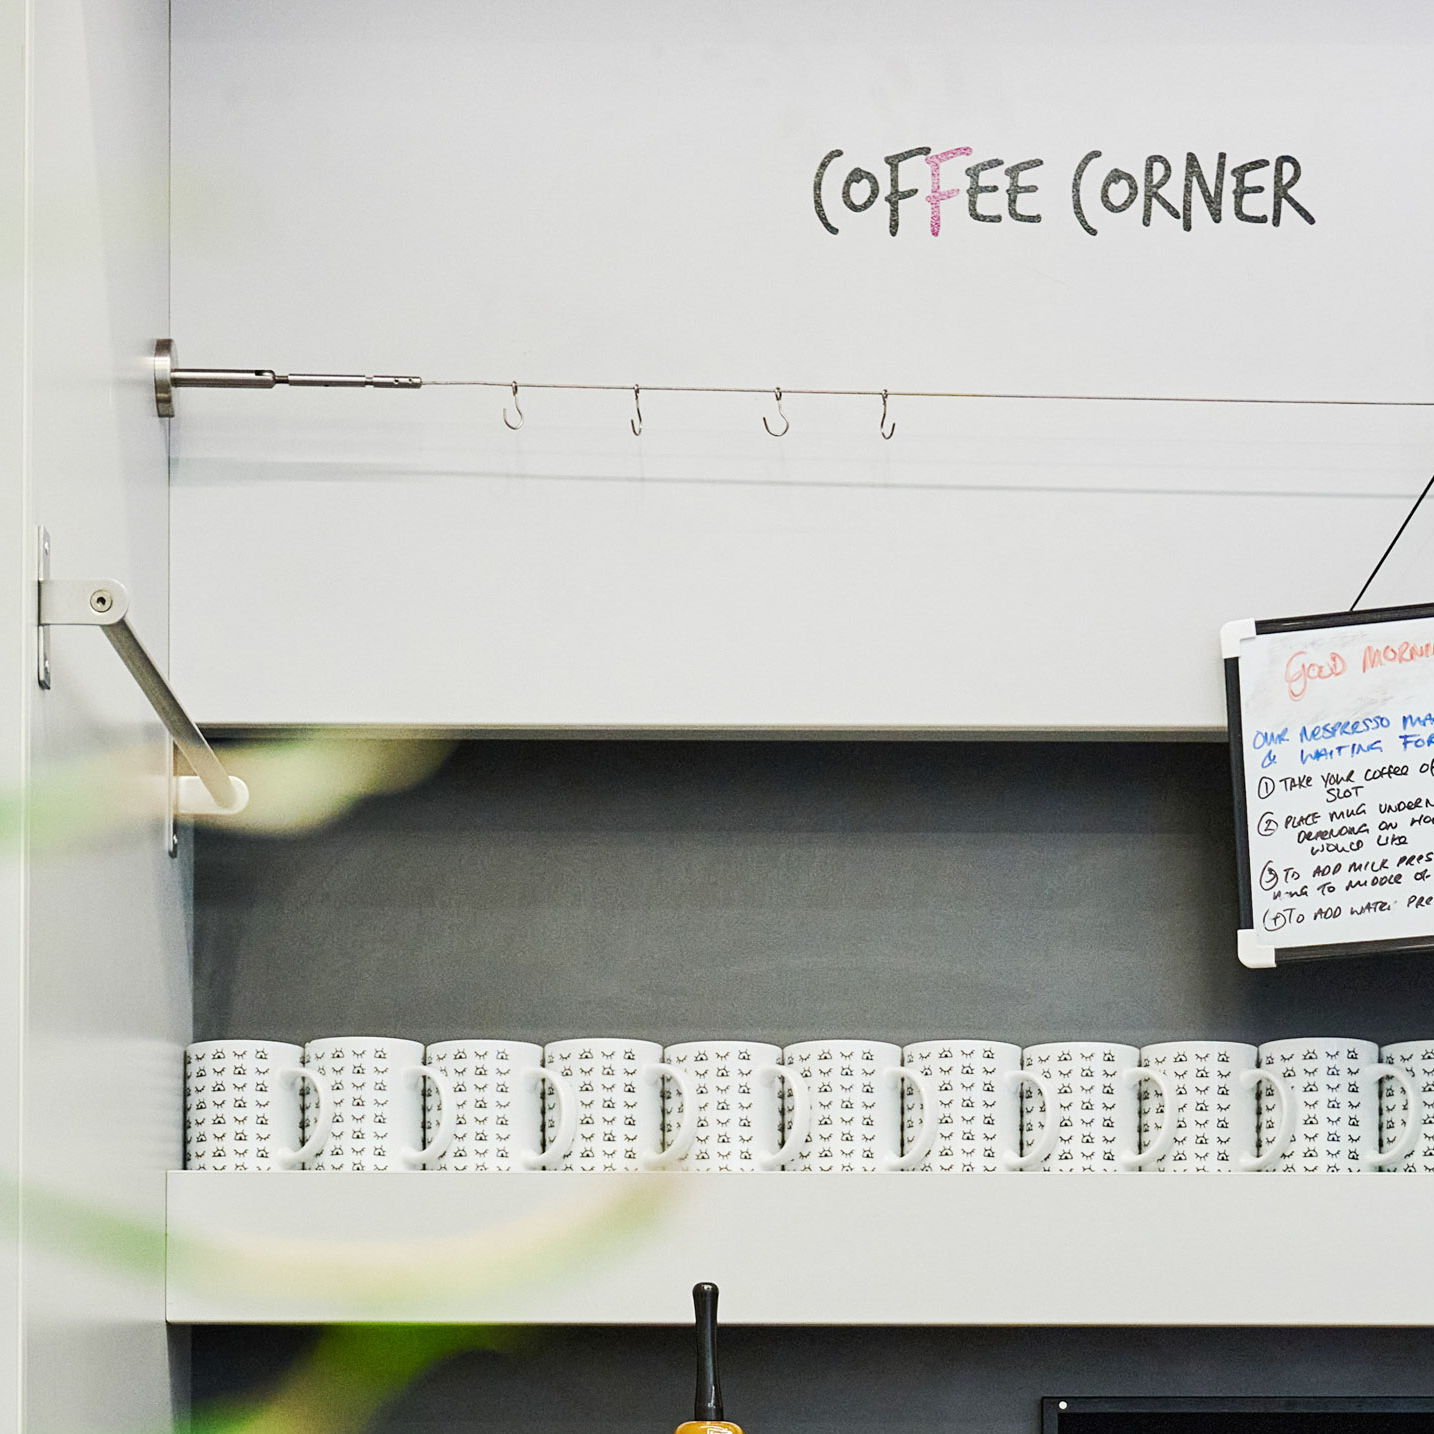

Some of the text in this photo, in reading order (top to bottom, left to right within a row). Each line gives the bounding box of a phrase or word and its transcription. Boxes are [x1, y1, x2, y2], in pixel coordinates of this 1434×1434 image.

[813, 146, 1317, 237] COFFEE CORNER
[1252, 727, 1290, 750] OUR
[1260, 748, 1278, 769] &
[1300, 740, 1384, 765] WAITING
[1320, 769, 1356, 789] YOUR
[1325, 785, 1365, 803] SLOT
[1283, 811, 1322, 830] PLACE
[1328, 802, 1368, 823] MUG
[1377, 819, 1399, 832] ON
[1312, 862, 1343, 878] ADD
[1347, 857, 1390, 874] MILK
[1316, 881, 1337, 897] TO
[1312, 905, 1343, 922] ADD
